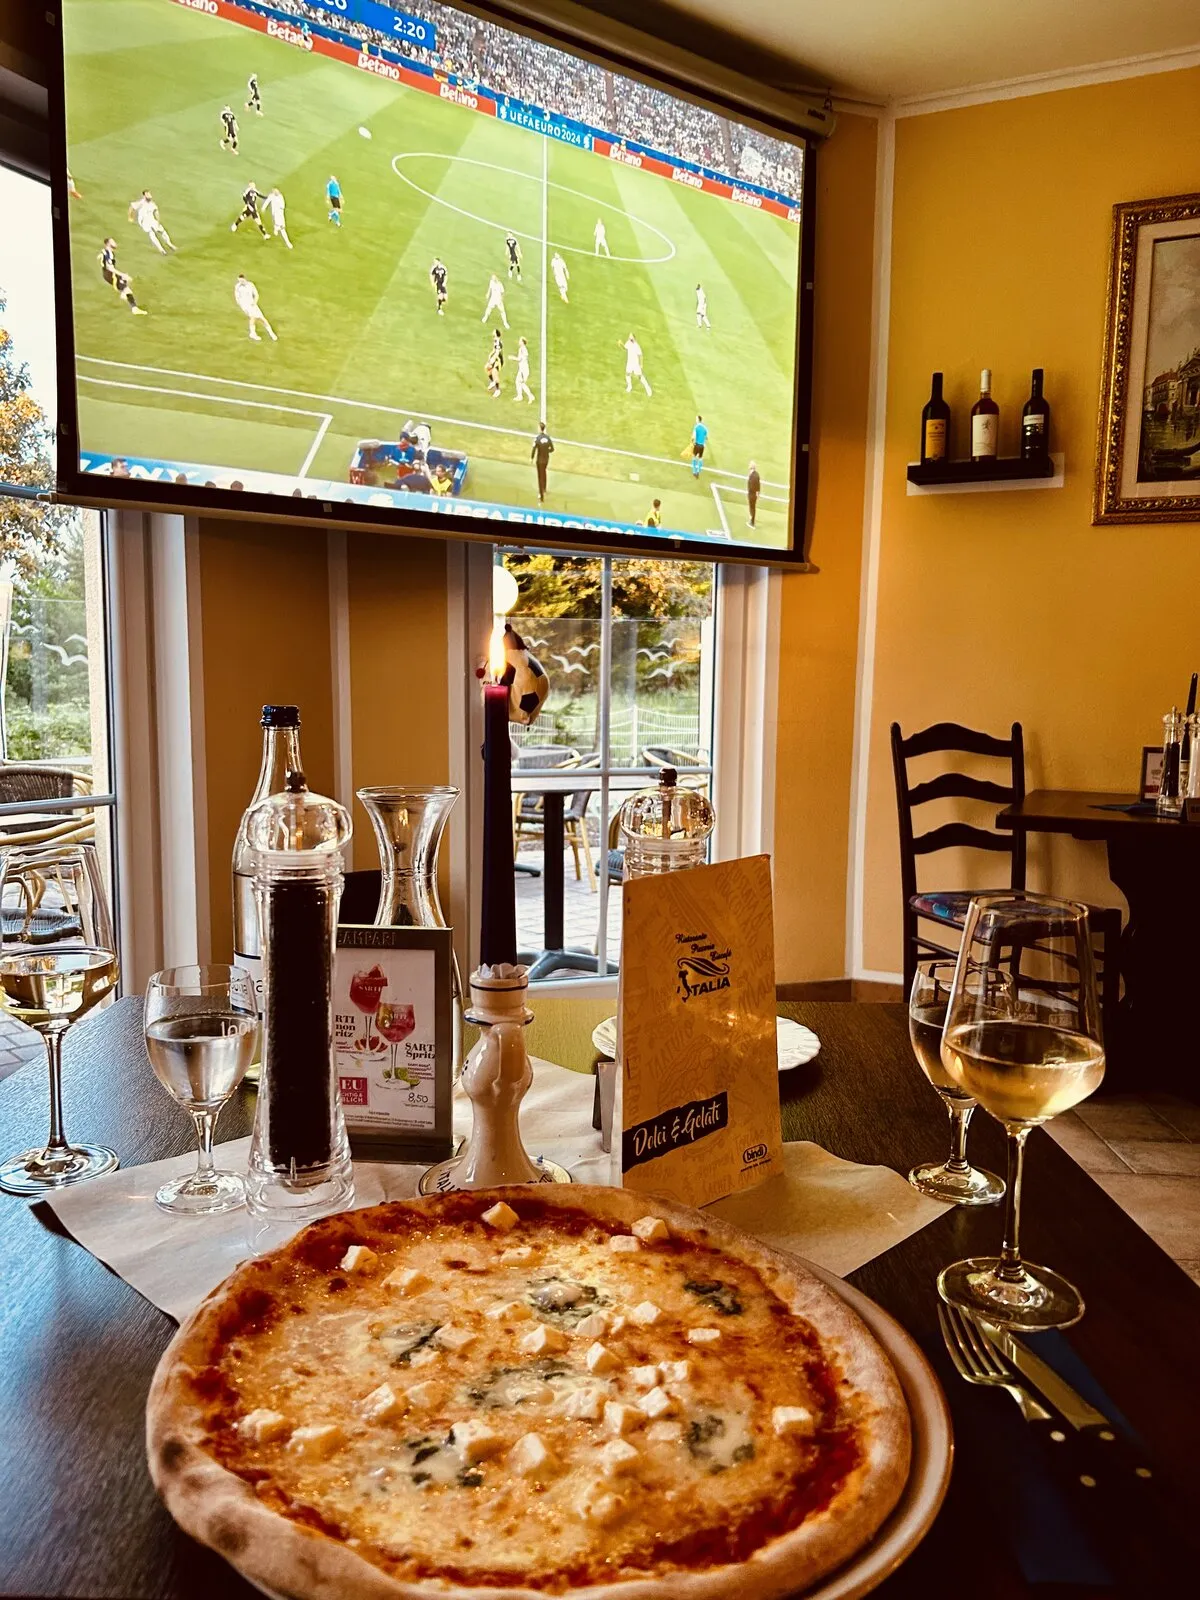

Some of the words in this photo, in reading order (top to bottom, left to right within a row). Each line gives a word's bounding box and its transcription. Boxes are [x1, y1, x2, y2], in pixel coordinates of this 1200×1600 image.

[179, 0, 219, 14] tano
[393, 17, 426, 40] 2:20
[357, 53, 400, 80] Betano
[672, 167, 703, 189] Betano
[335, 1014, 355, 1024] RTI
[335, 1029, 354, 1038] ritz
[405, 1042, 435, 1051] SART
[341, 1079, 362, 1090] EU
[408, 1092, 429, 1104] 8,50
[632, 1125, 667, 1157] Dolci
[671, 1116, 681, 1143] &
[681, 1100, 722, 1141] Gelati
